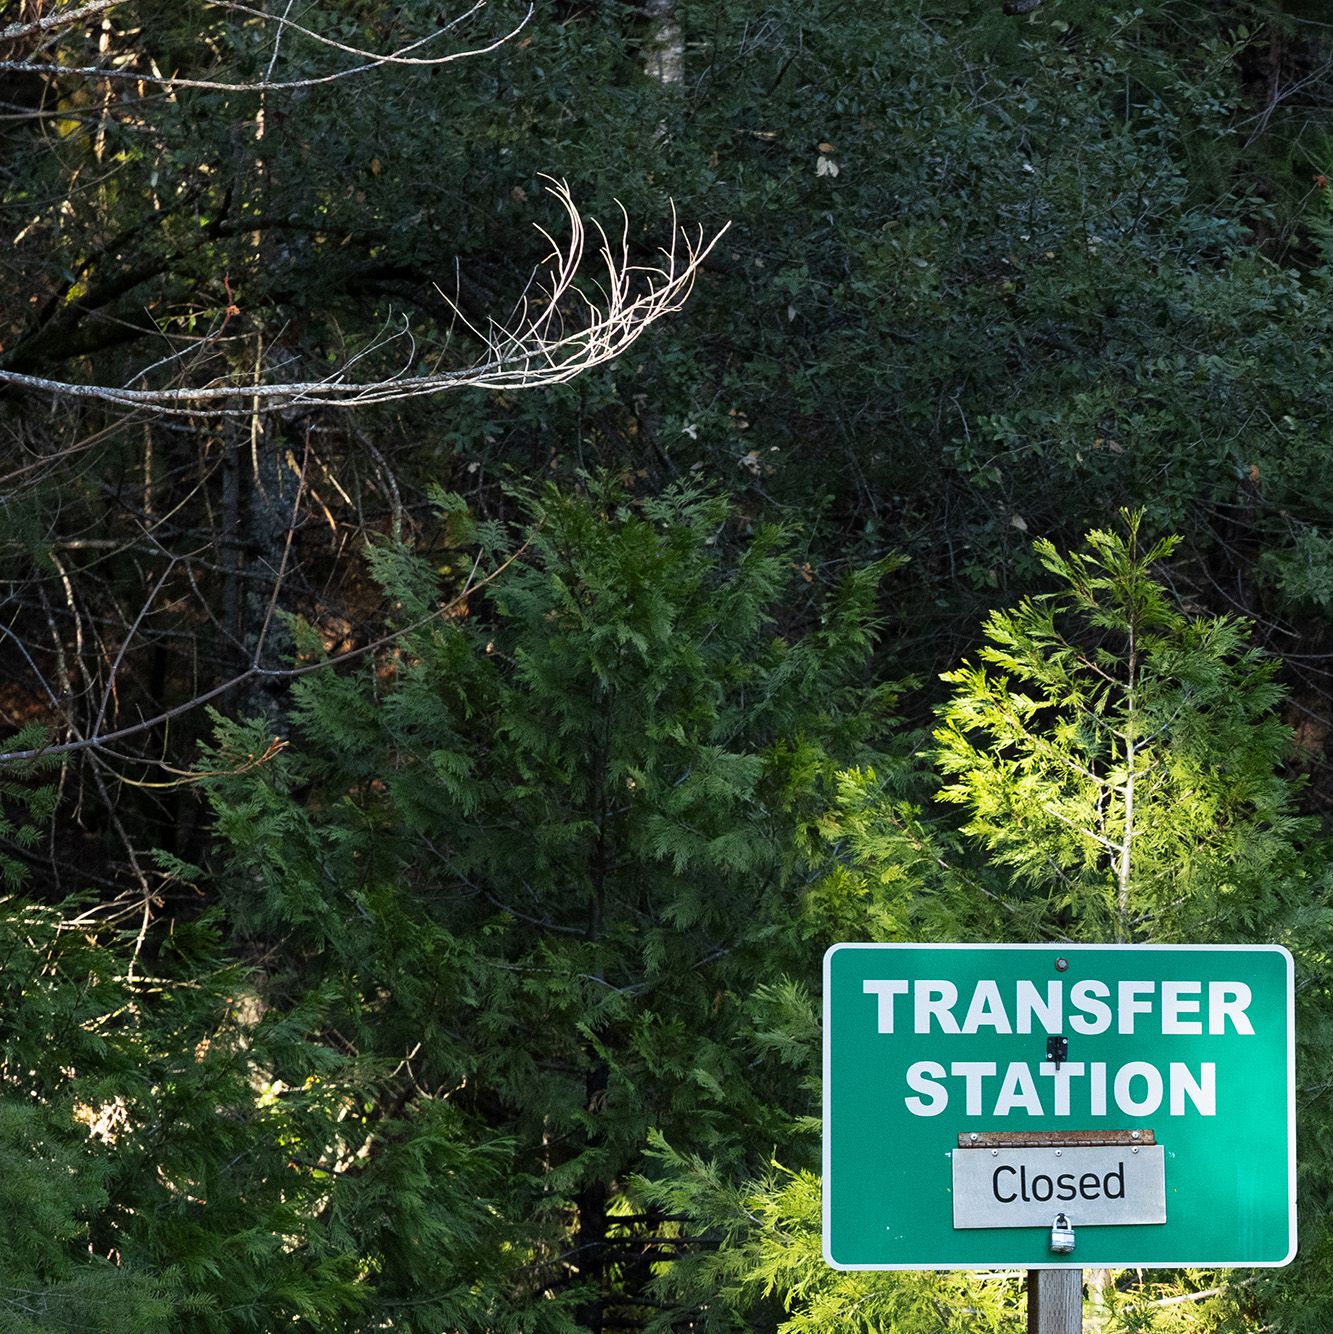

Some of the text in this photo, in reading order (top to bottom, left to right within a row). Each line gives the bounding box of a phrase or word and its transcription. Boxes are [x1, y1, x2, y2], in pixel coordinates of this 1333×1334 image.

[863, 979, 1255, 1035] TRANSFER
[904, 1061, 1216, 1116] STATION
[992, 1162, 1125, 1202] Closed
